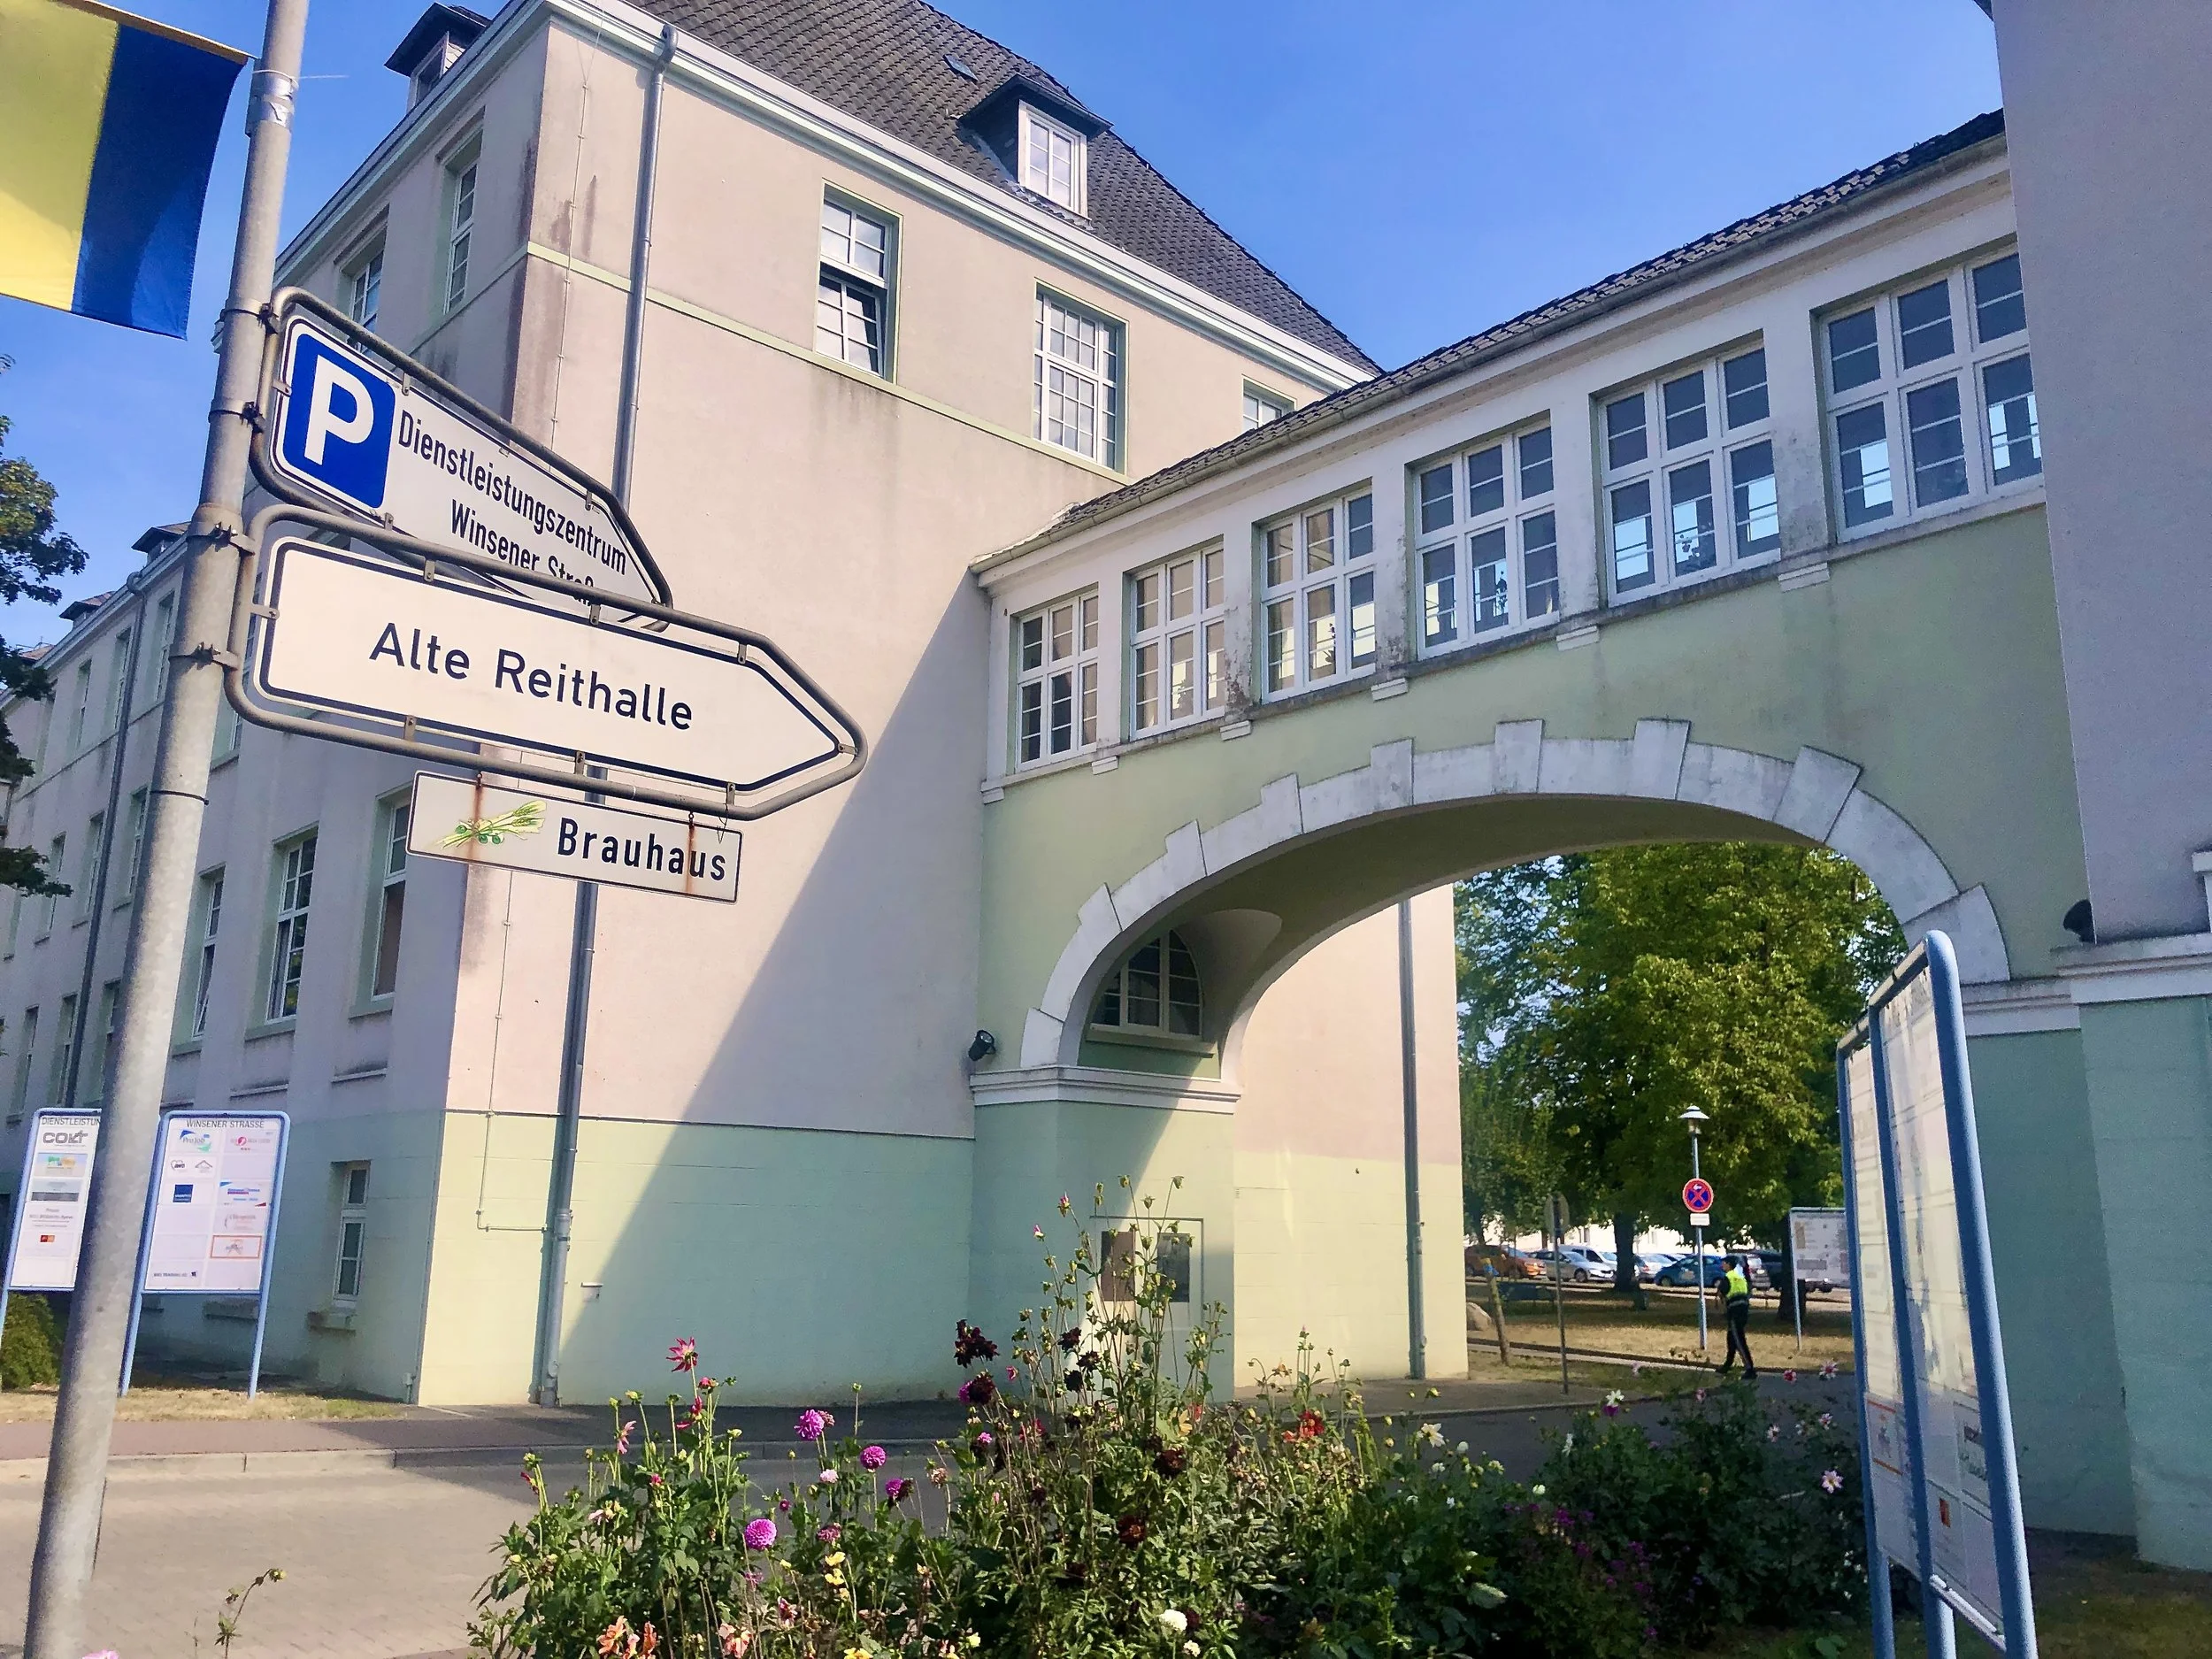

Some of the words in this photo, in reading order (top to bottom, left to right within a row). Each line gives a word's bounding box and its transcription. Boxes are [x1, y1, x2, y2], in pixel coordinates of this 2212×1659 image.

[303, 354, 375, 465] P
[398, 409, 626, 576] Dienstleistungszentrum
[451, 498, 540, 571] Winsener
[369, 622, 471, 680] Alte
[495, 649, 693, 730] Reithalle
[557, 817, 726, 881] Brauhaus
[186, 1119, 227, 1128] WINSENER
[229, 1120, 265, 1129] STRASSE
